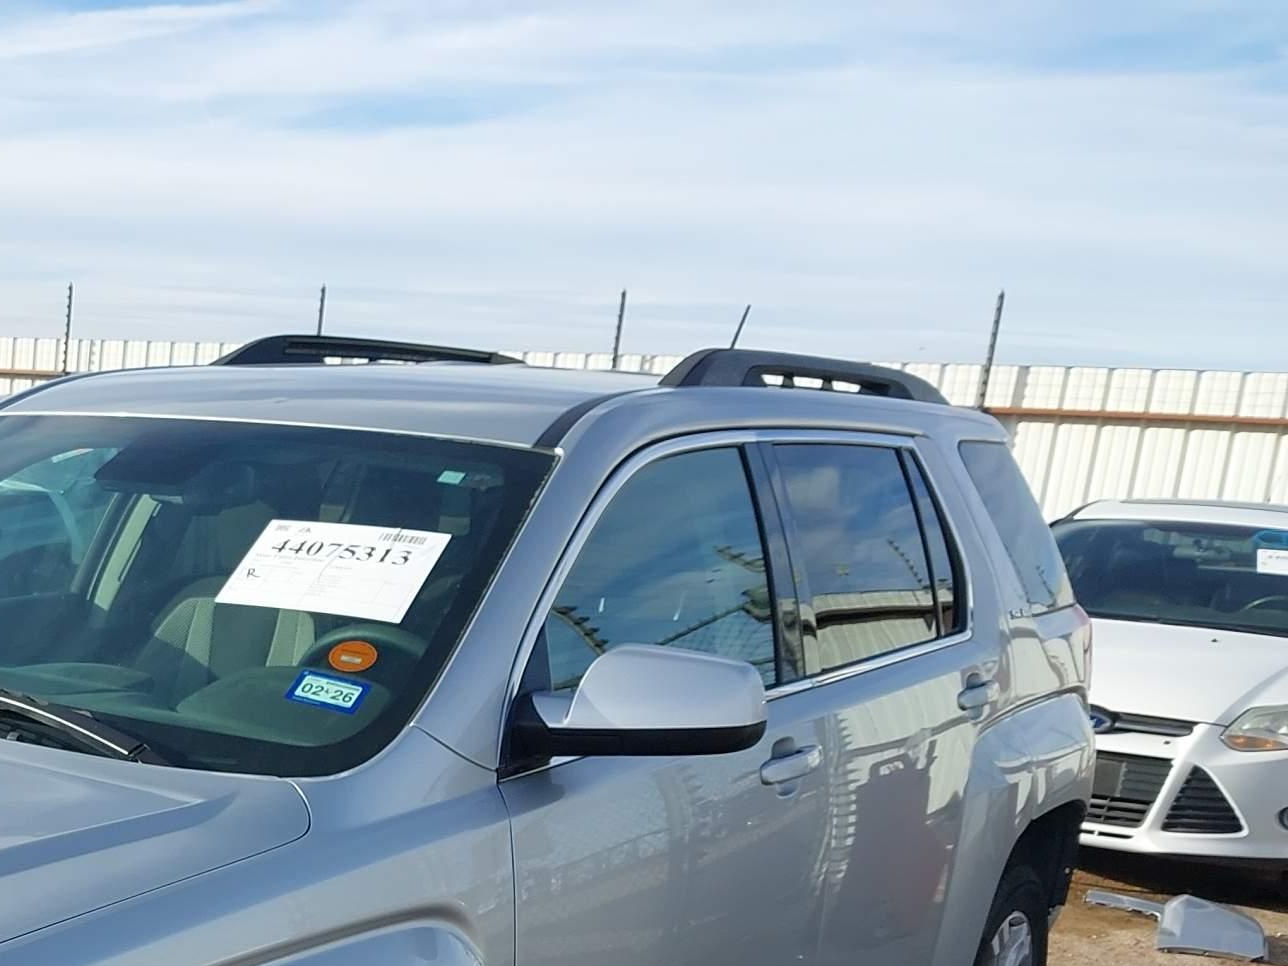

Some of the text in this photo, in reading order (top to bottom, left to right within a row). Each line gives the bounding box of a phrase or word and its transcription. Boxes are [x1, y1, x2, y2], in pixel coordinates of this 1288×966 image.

[271, 539, 413, 566] 44075313
[246, 568, 260, 578] R
[301, 683, 324, 697] 02
[329, 689, 356, 704] 26
